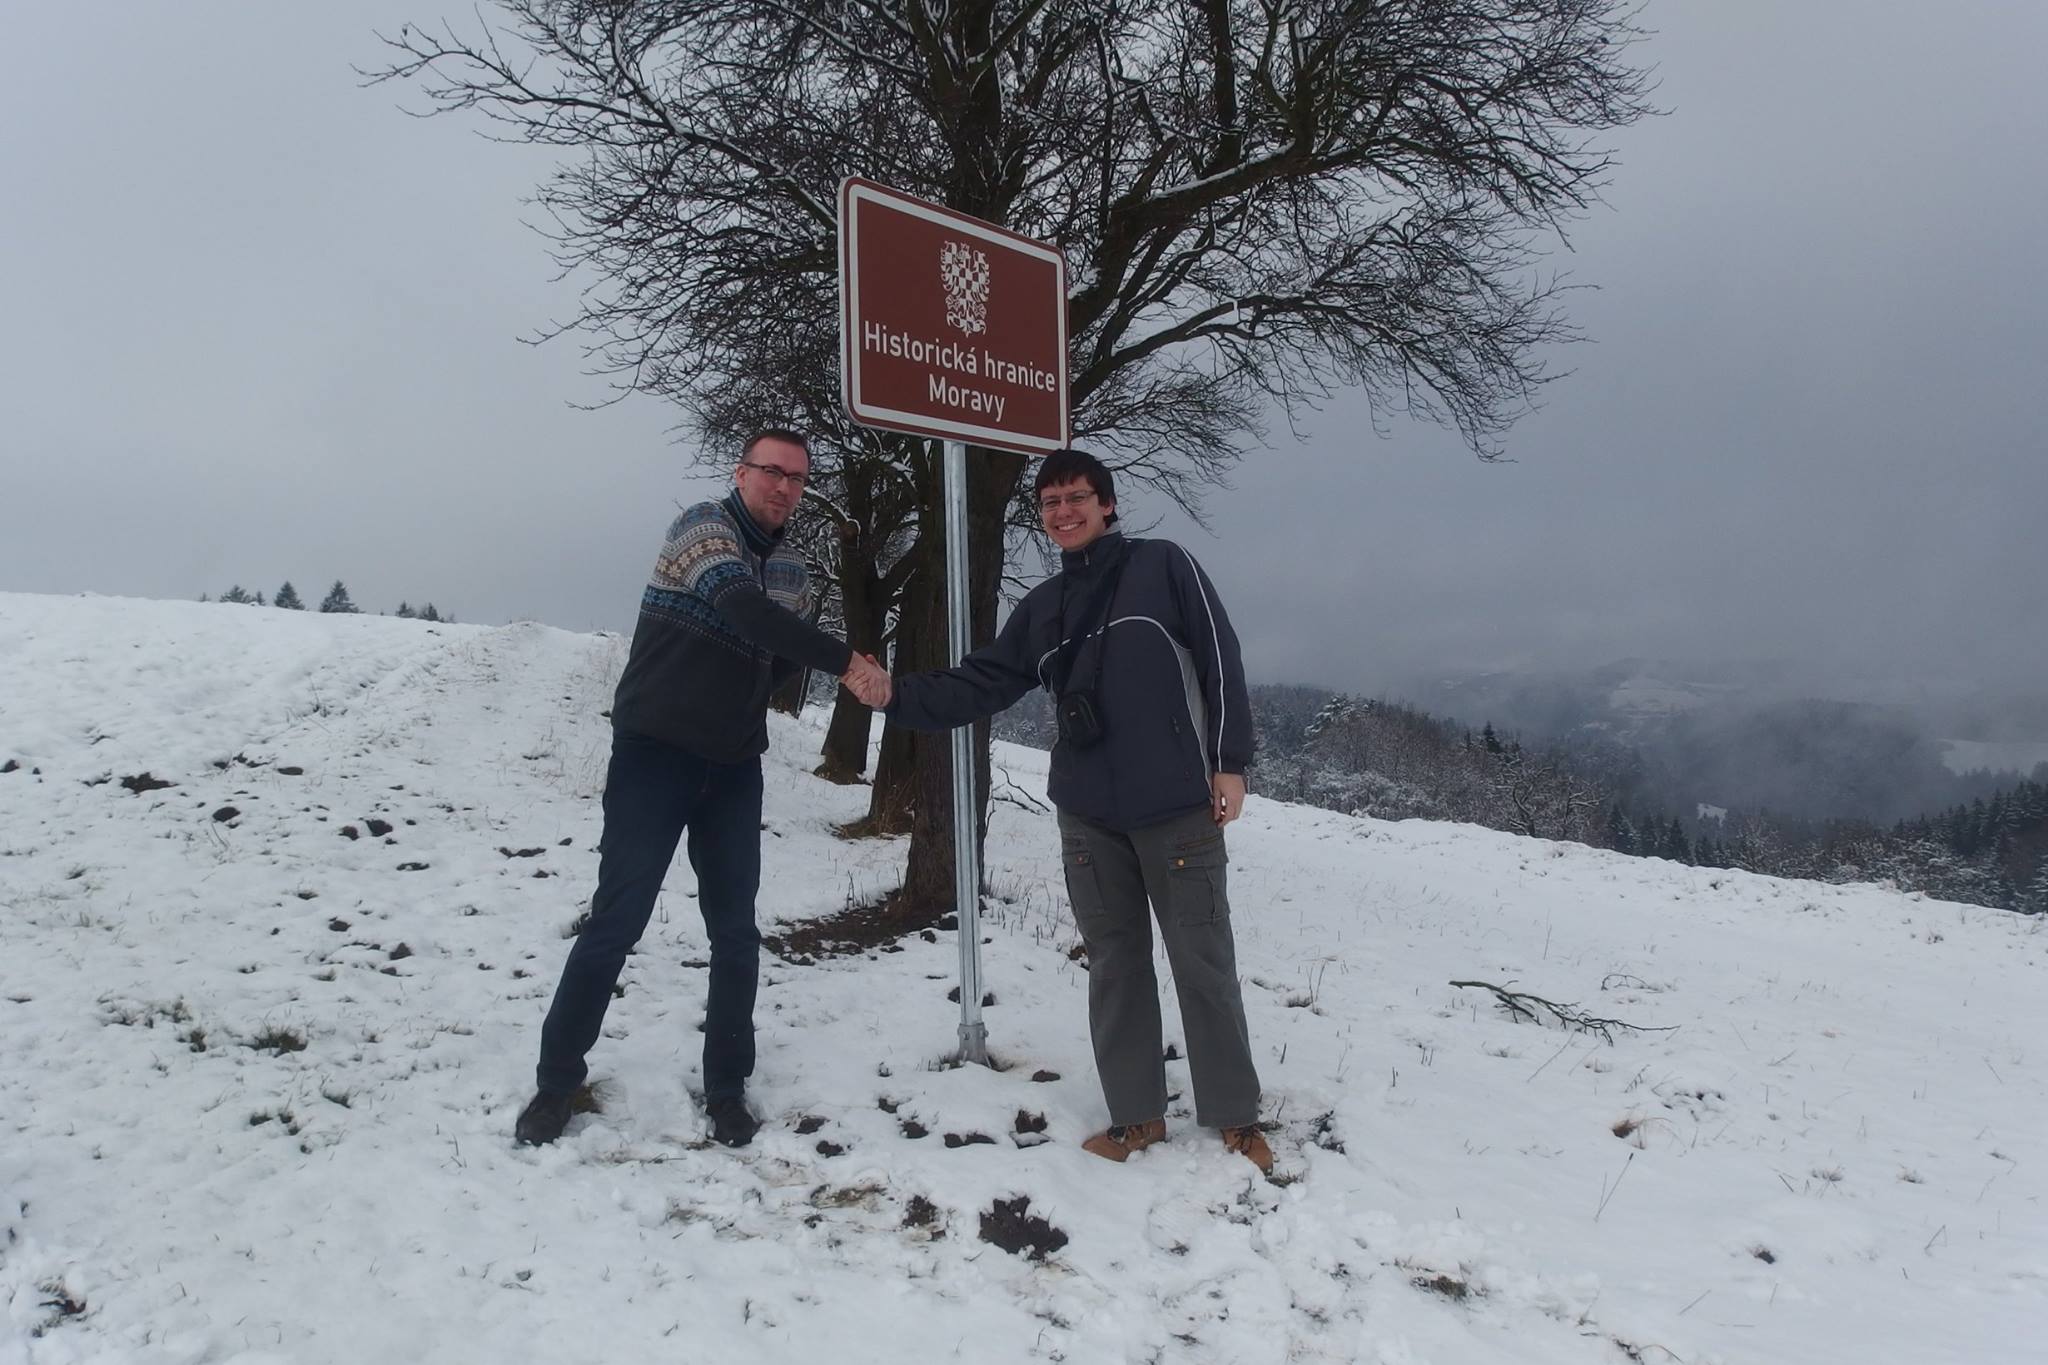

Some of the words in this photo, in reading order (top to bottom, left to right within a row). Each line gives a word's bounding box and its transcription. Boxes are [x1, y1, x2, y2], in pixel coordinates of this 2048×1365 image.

[864, 320, 977, 374] Historická
[984, 350, 1056, 392] hranice
[929, 374, 1005, 422] Moravy
